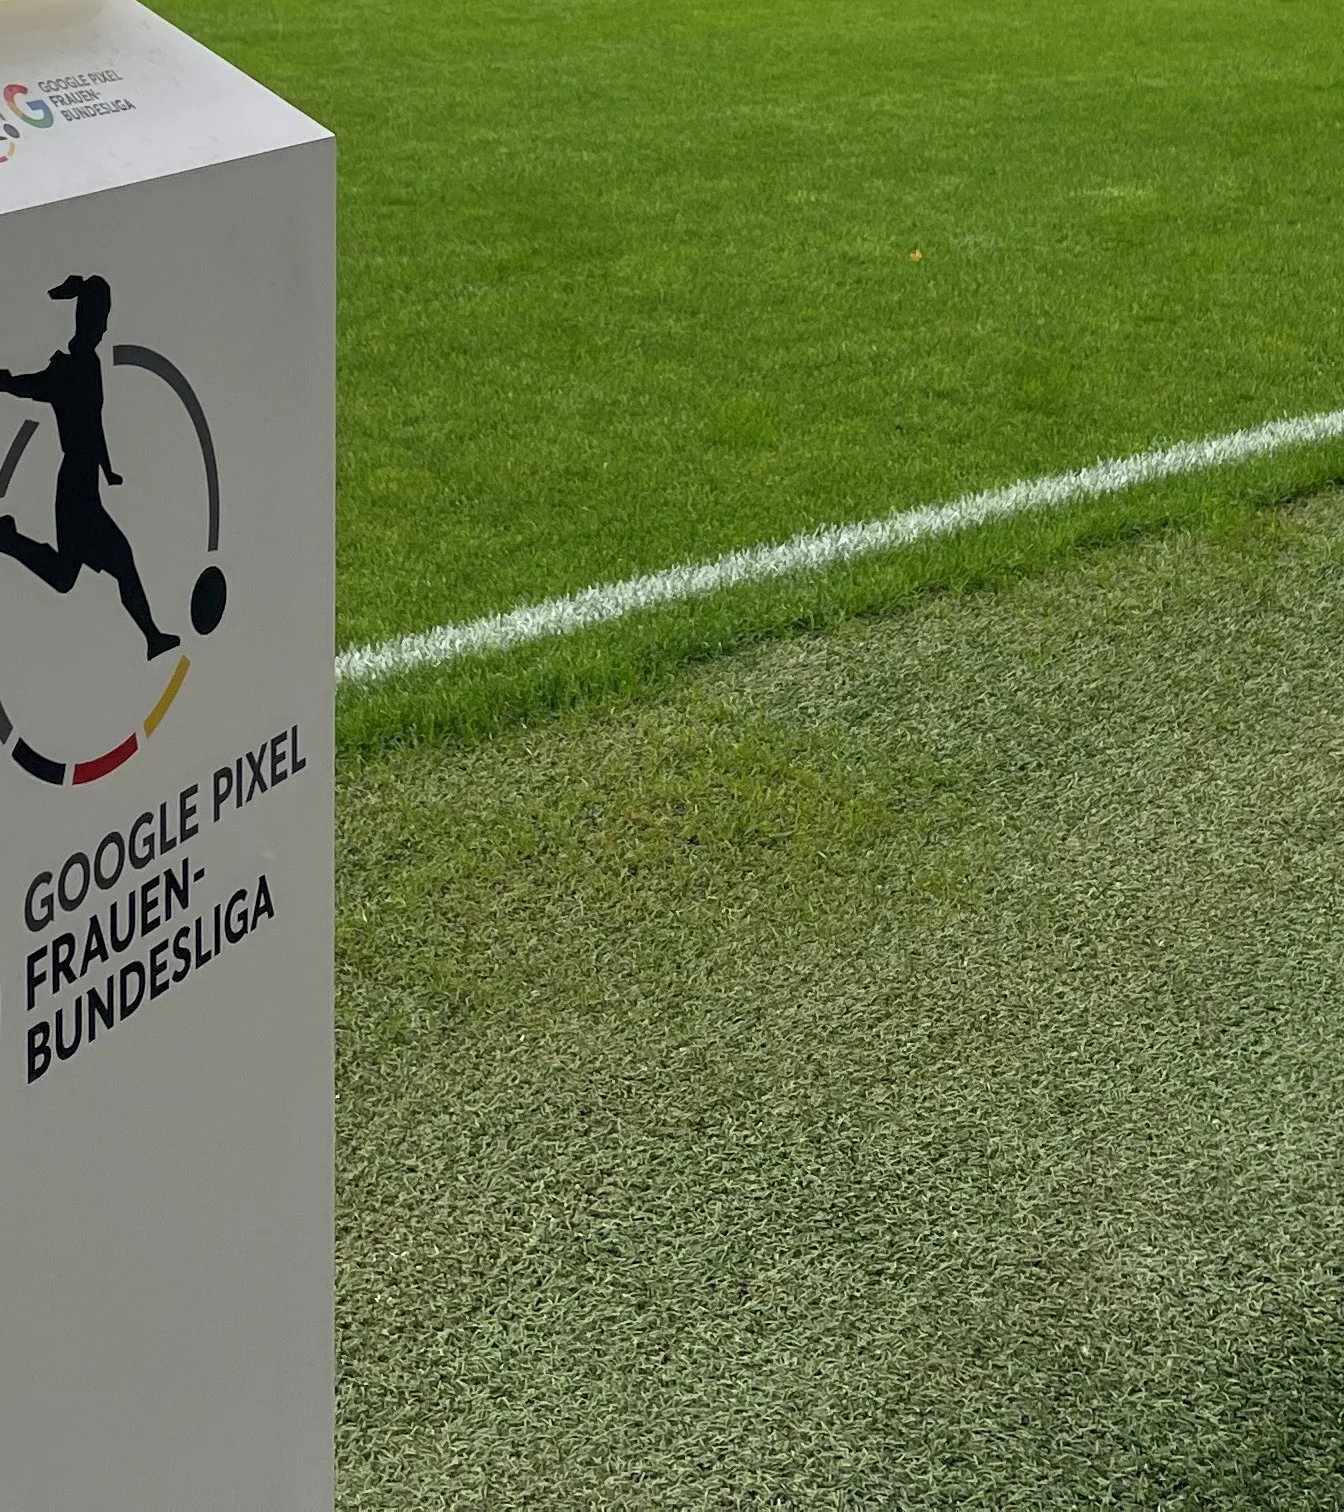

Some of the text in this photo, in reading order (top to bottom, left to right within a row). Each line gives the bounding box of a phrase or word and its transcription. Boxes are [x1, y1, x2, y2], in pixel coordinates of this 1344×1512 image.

[38, 69, 124, 93] GOOGLE PIXEL
[48, 89, 102, 108] FRAUEN-
[59, 98, 137, 123] BUNDESLIGA
[24, 724, 307, 932] GOOGLE PIXEL
[26, 857, 206, 1012] FRAUEN-
[27, 874, 275, 1085] BUNDESLIGA
